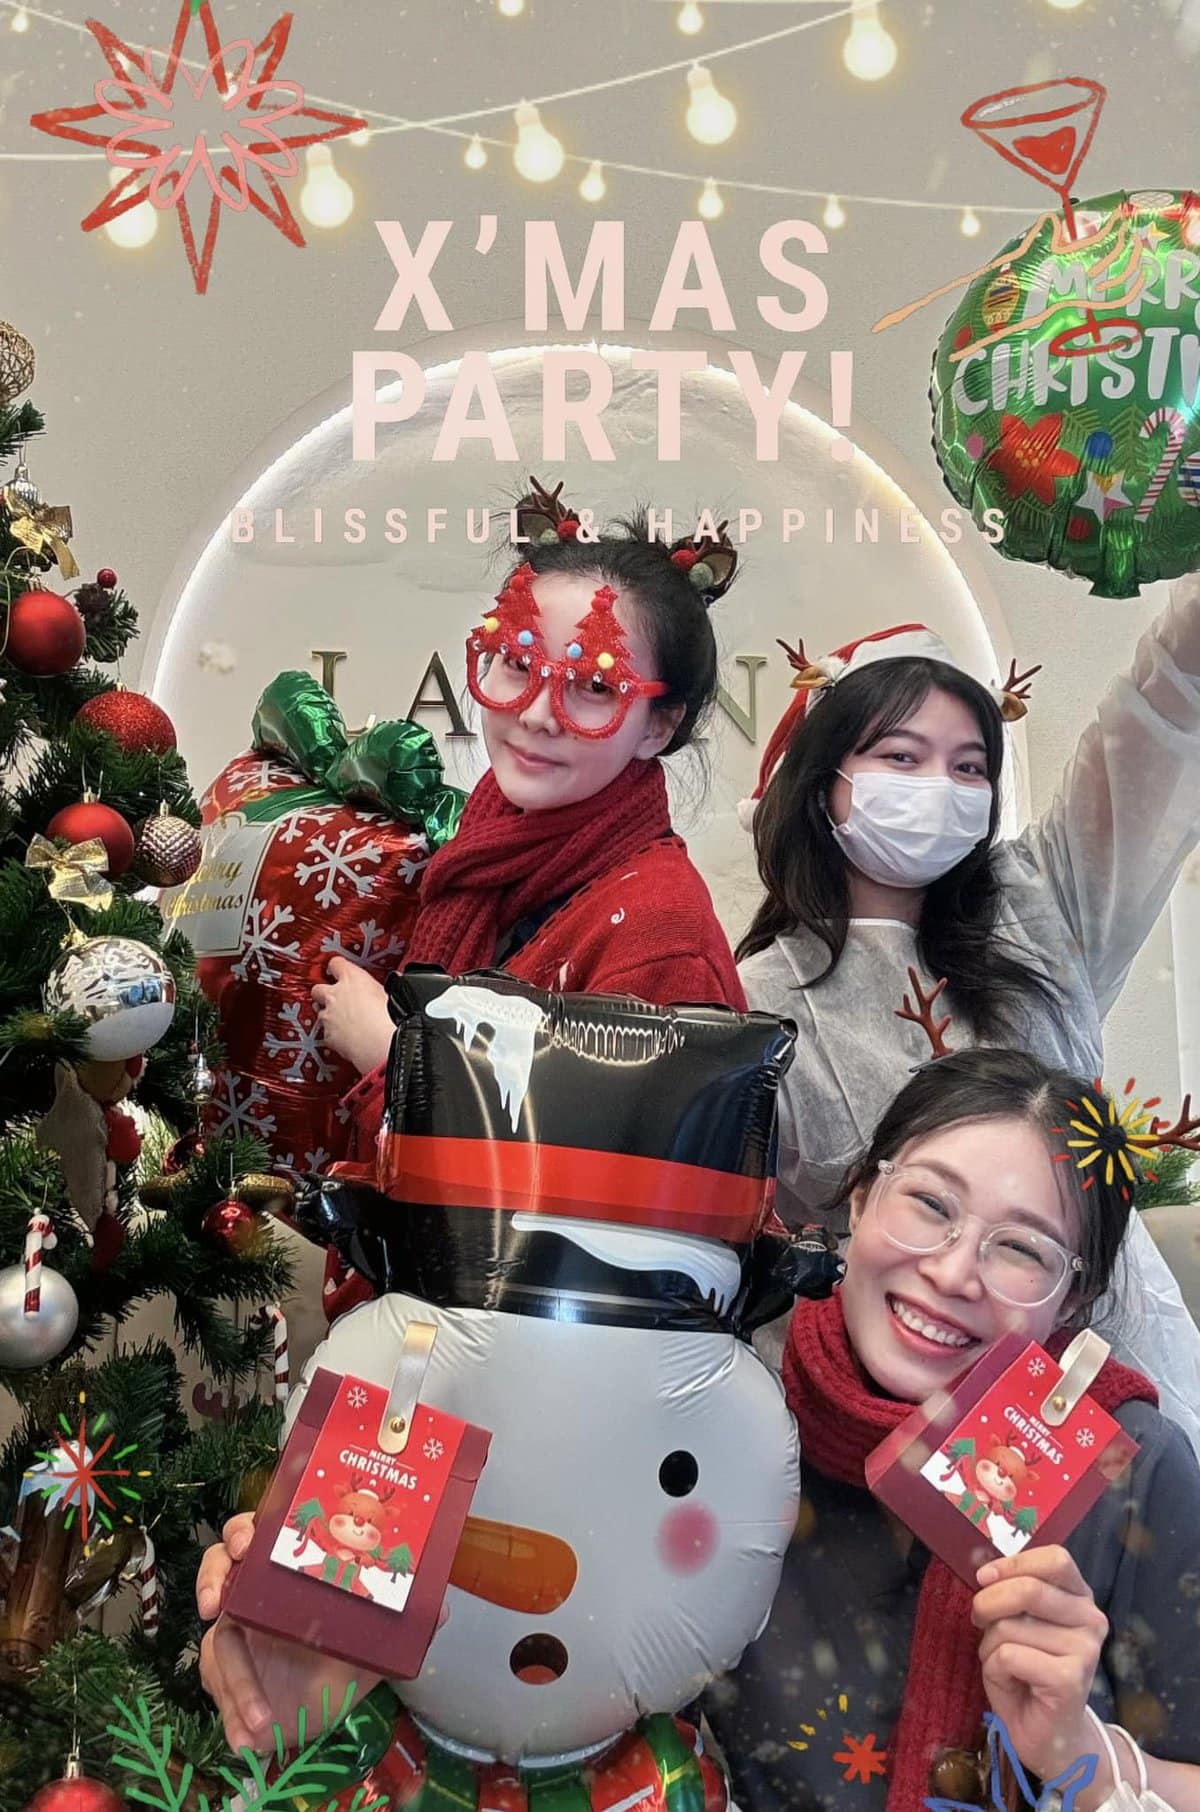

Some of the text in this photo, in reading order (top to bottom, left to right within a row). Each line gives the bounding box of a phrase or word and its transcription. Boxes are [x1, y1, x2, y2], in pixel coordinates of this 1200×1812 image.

[1021, 249, 1200, 329] MRR
[1003, 1406, 1064, 1465] CHRISTMAS
[1029, 1416, 1052, 1437] MERRY
[339, 1449, 418, 1490] CHRISTMAS
[368, 1449, 397, 1466] MERRY
